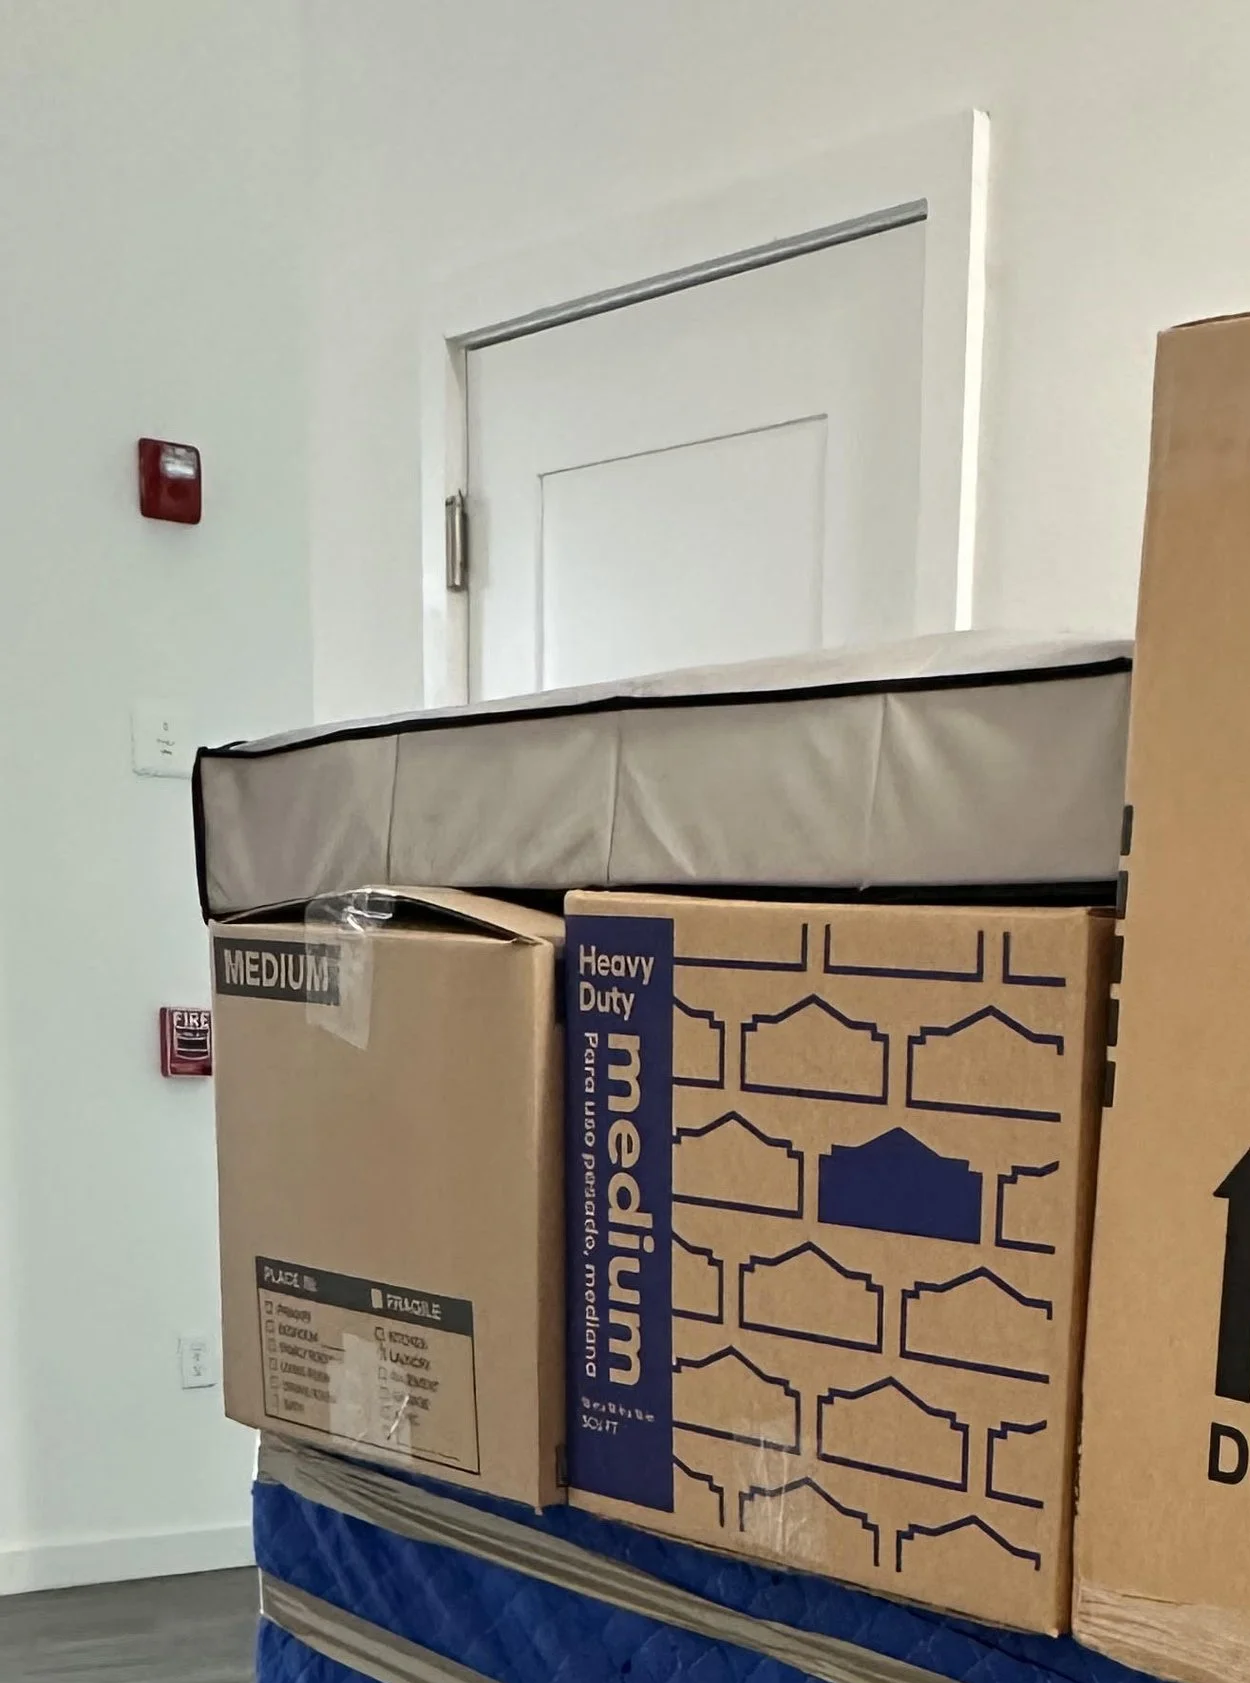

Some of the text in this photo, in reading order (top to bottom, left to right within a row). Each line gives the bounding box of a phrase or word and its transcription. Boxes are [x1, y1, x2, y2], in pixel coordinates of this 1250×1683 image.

[224, 948, 329, 992] MEDIUM
[579, 943, 655, 985] Heavy
[173, 1011, 210, 1028] FIRE
[579, 981, 635, 1021] Duty
[584, 1032, 599, 1093] Para
[584, 1101, 596, 1147] uso
[607, 1033, 655, 1386] medium
[386, 1293, 442, 1321] FRAGILE
[584, 1263, 600, 1379] mediana
